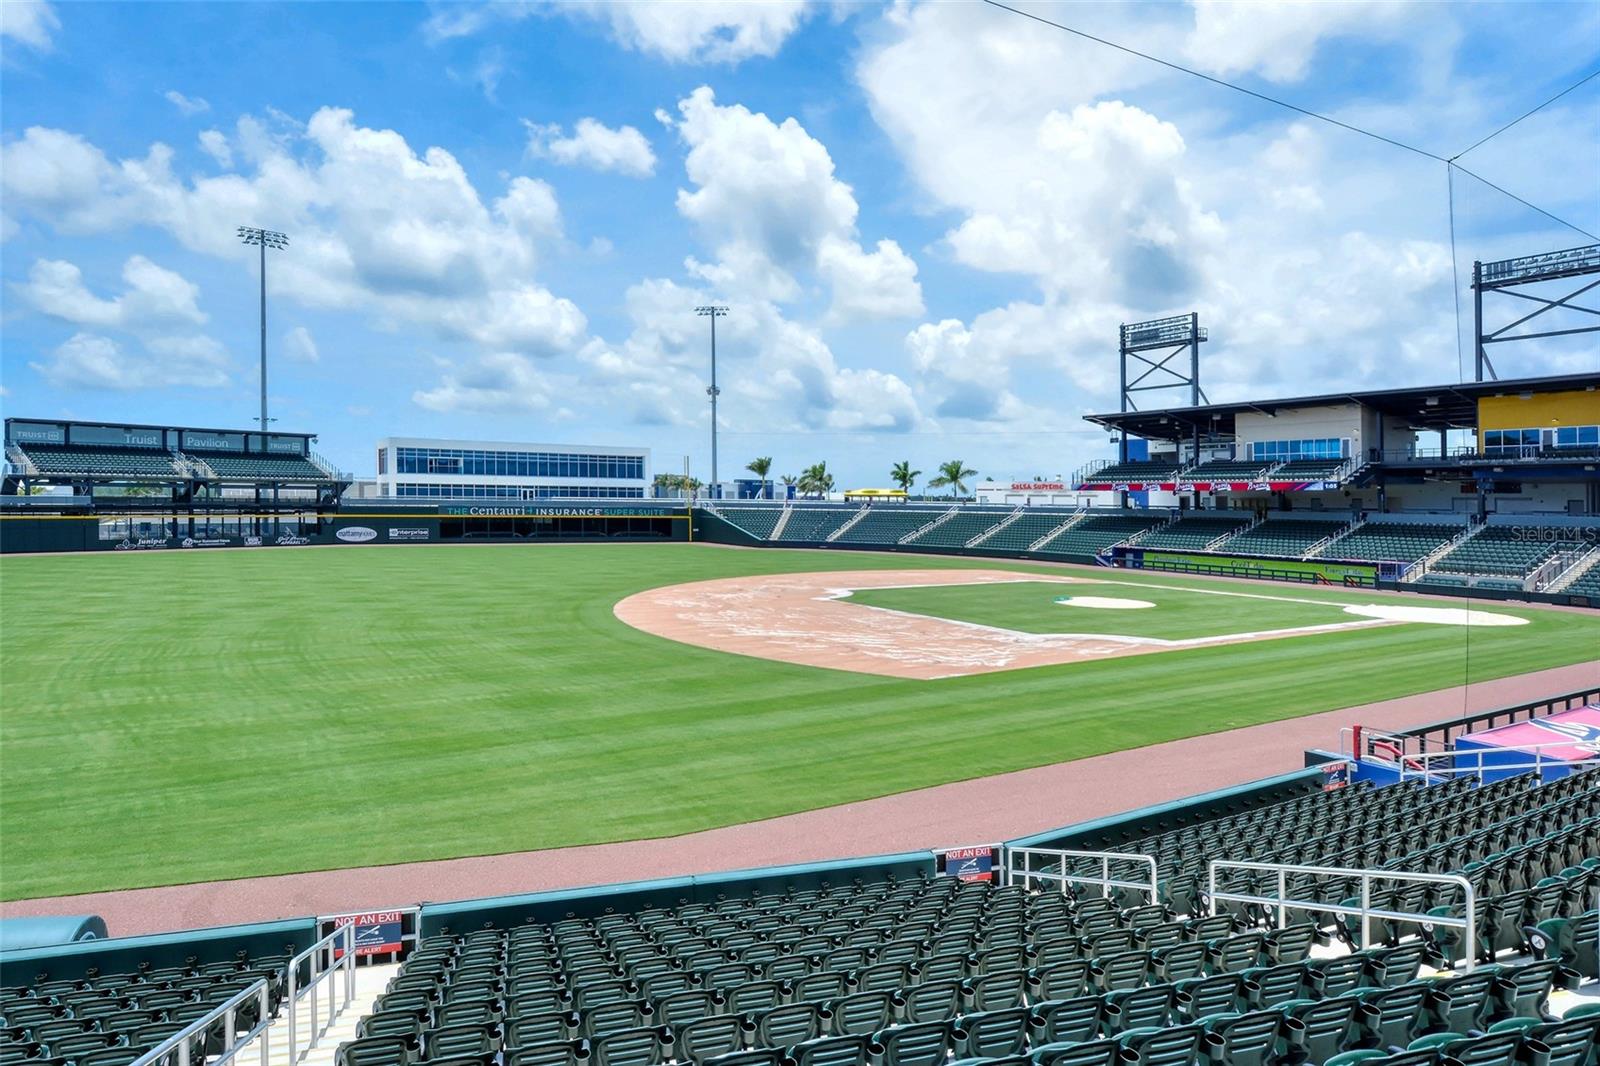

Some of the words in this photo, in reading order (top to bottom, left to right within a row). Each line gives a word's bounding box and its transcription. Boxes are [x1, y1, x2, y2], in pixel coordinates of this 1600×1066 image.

[16, 431, 47, 439] TRUIST
[123, 434, 158, 446] Truist
[187, 437, 229, 449] Pavilion
[447, 507, 469, 516] THE
[470, 505, 526, 516] Centauri
[536, 508, 601, 516] INSURANCE
[946, 850, 961, 859] NOT
[962, 849, 975, 857] AN
[976, 847, 991, 855] EXIT
[359, 914, 376, 925] AN
[378, 912, 400, 923] EXIT
[364, 946, 382, 954] ALERT
